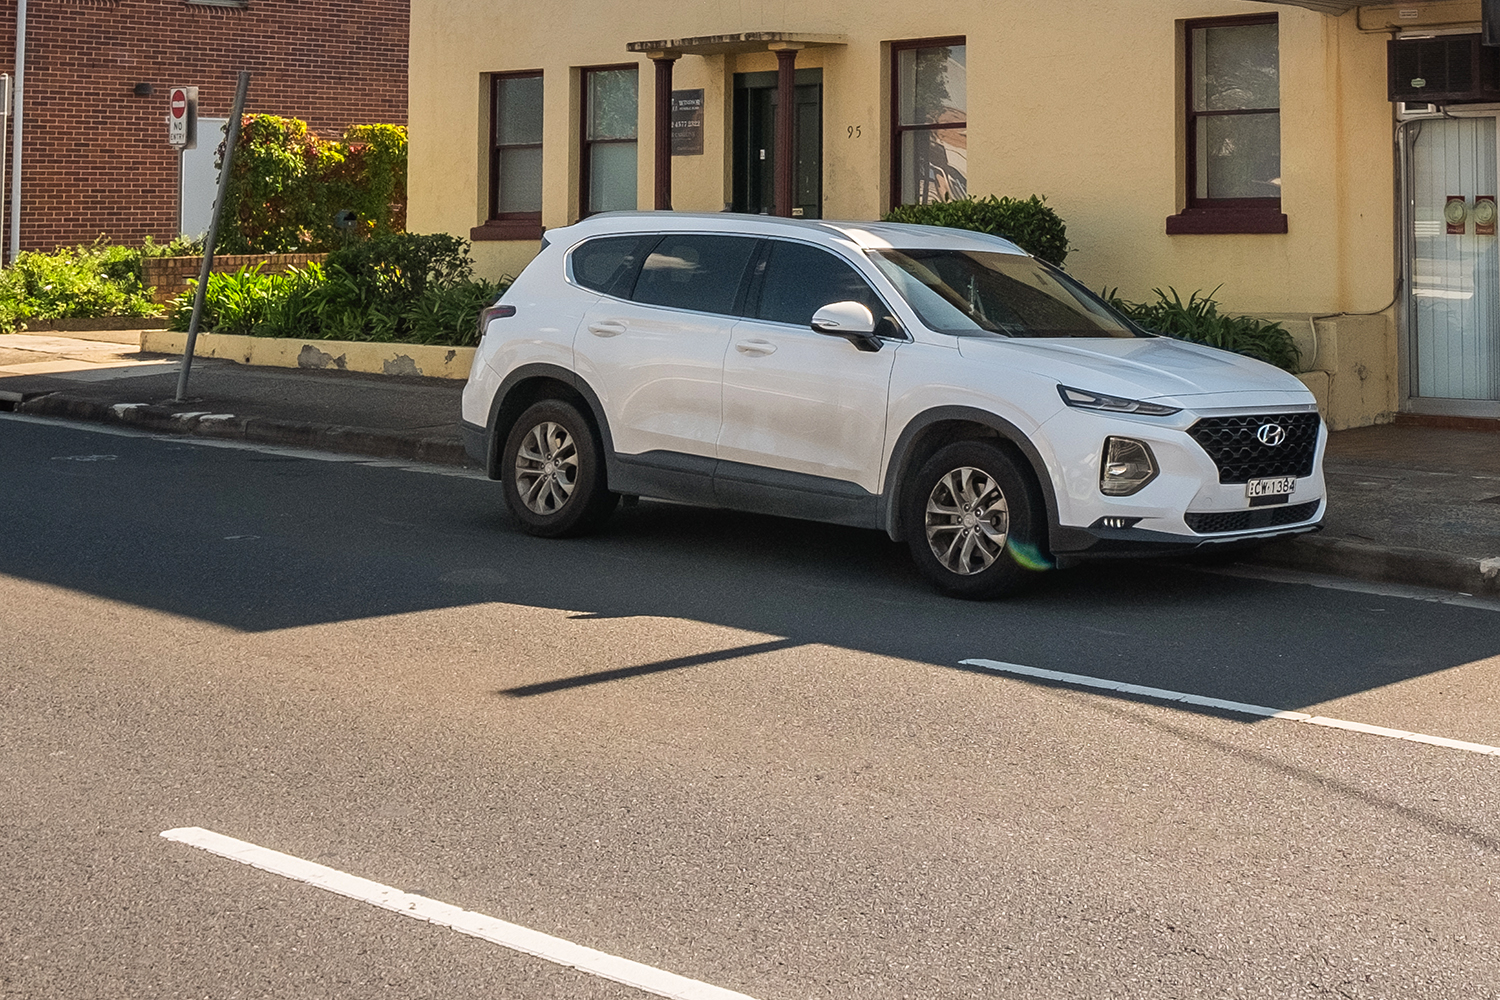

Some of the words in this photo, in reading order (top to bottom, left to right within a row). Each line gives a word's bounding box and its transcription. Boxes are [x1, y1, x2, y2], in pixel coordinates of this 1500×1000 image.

[174, 122, 183, 131] NO
[847, 125, 862, 139] 95
[170, 133, 185, 141] ENTRY
